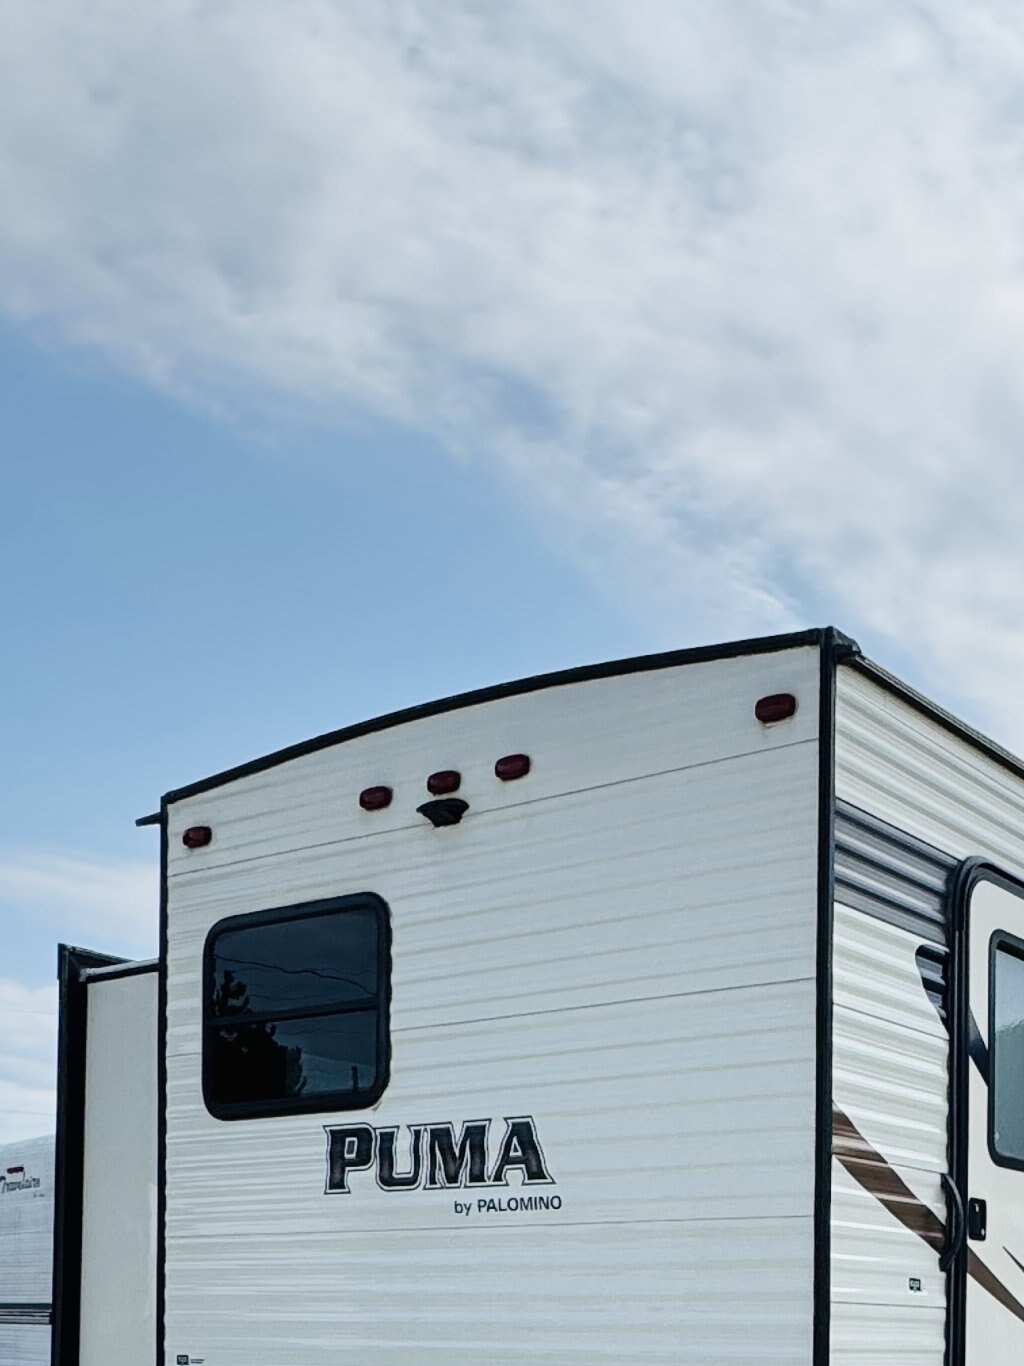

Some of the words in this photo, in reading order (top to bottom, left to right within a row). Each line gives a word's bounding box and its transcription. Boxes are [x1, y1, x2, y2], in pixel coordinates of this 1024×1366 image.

[322, 1115, 557, 1195] PUMA
[454, 1200, 472, 1216] by
[477, 1195, 562, 1213] PALOMINO
